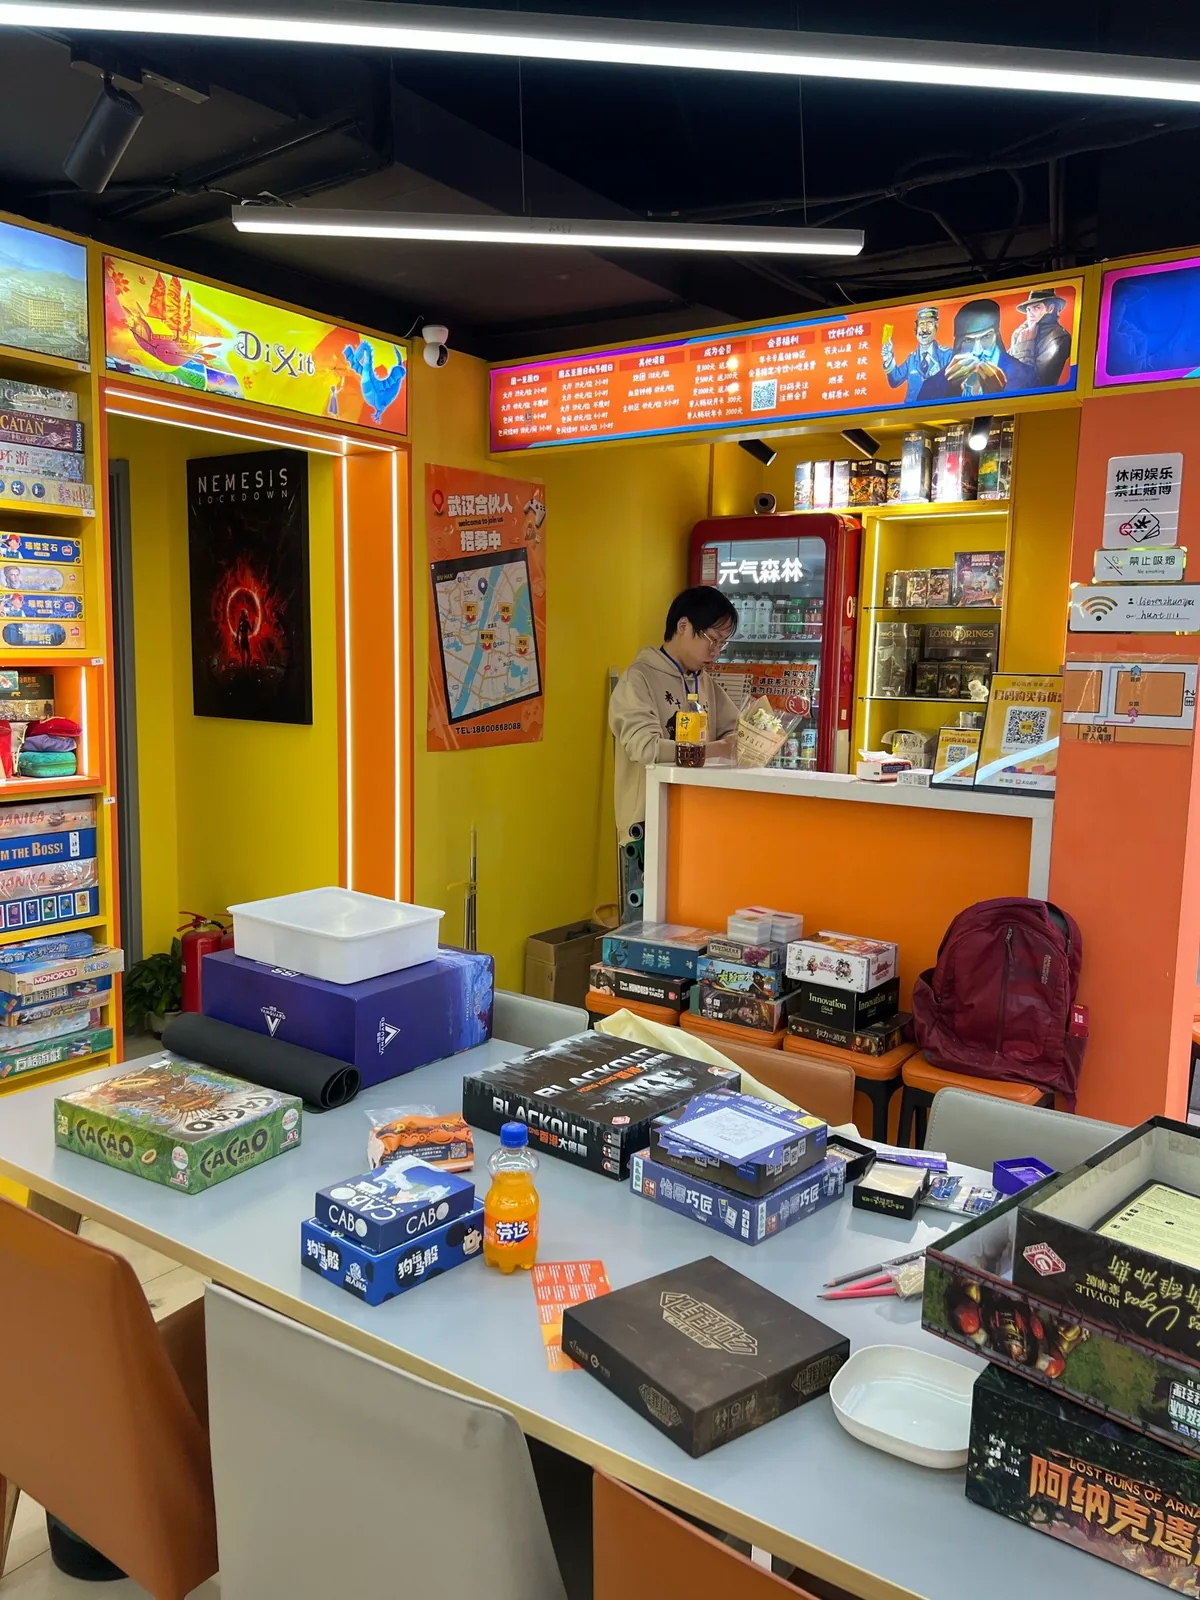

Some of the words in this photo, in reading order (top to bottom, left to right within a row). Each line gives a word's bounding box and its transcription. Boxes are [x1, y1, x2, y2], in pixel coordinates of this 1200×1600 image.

[767, 335, 799, 348] 会员福利
[828, 325, 864, 340] 饮料价格
[703, 344, 732, 357] 成为会员
[824, 343, 852, 354] 农夫山泉
[638, 355, 665, 368] 其他项目
[0, 415, 44, 435] CATAN
[198, 468, 288, 493] NEMESIS
[1116, 466, 1173, 482] 休闲娱乐
[198, 490, 287, 505] LOCKDOWN
[1115, 482, 1172, 497] 禁止赌博
[447, 493, 513, 517] 武汉合伙人
[458, 519, 481, 527] welcome
[460, 530, 501, 552] 招募中
[1129, 555, 1176, 565] 禁止吸烟
[718, 557, 803, 585] 元气森林
[929, 629, 953, 638] LORD
[966, 630, 994, 638] RINGS
[12, 847, 29, 859] THE
[34, 968, 77, 985] MONOPOLY
[808, 992, 847, 1011] Innovation
[858, 993, 886, 1011] Innovation
[260, 1007, 287, 1020] VANGUARD
[533, 1048, 650, 1098] BLACKOUT
[492, 1096, 588, 1143] BLACKOUT
[76, 1119, 134, 1160] CACAO
[200, 1128, 269, 1179] CACAO
[634, 1161, 643, 1188] TOPP
[328, 1205, 368, 1238] CABO
[406, 1202, 450, 1235] CABO
[495, 1221, 530, 1240] 芬达
[1075, 1283, 1120, 1309] ROYALE
[1123, 1290, 1180, 1332] Vegas
[1069, 1458, 1102, 1480] LOST
[1104, 1472, 1140, 1497] RUINS
[1144, 1489, 1162, 1504] OF
[1029, 1453, 1200, 1568] 阿纳克遗
